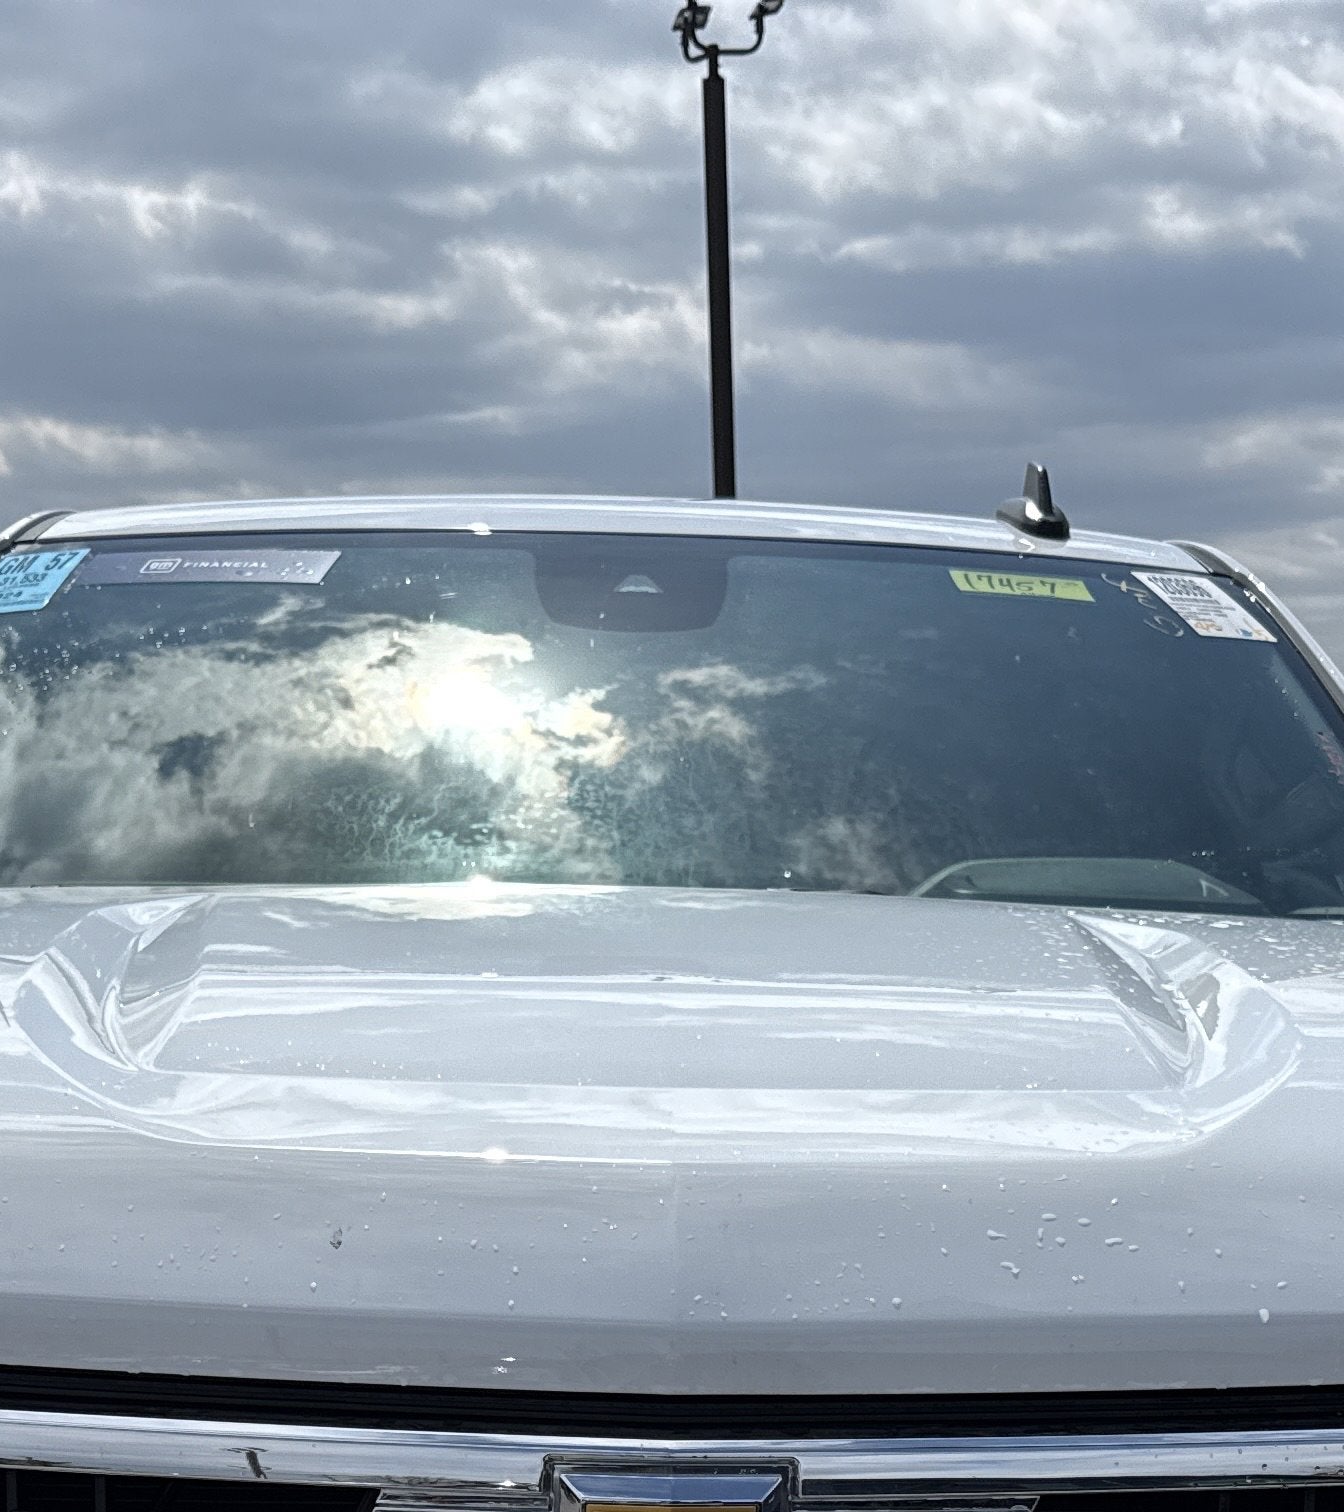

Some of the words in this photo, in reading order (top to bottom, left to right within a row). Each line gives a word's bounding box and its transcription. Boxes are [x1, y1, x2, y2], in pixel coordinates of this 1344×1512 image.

[44, 551, 80, 570] 57
[183, 561, 269, 569] FINANCIAL
[964, 573, 1057, 594] 17457
